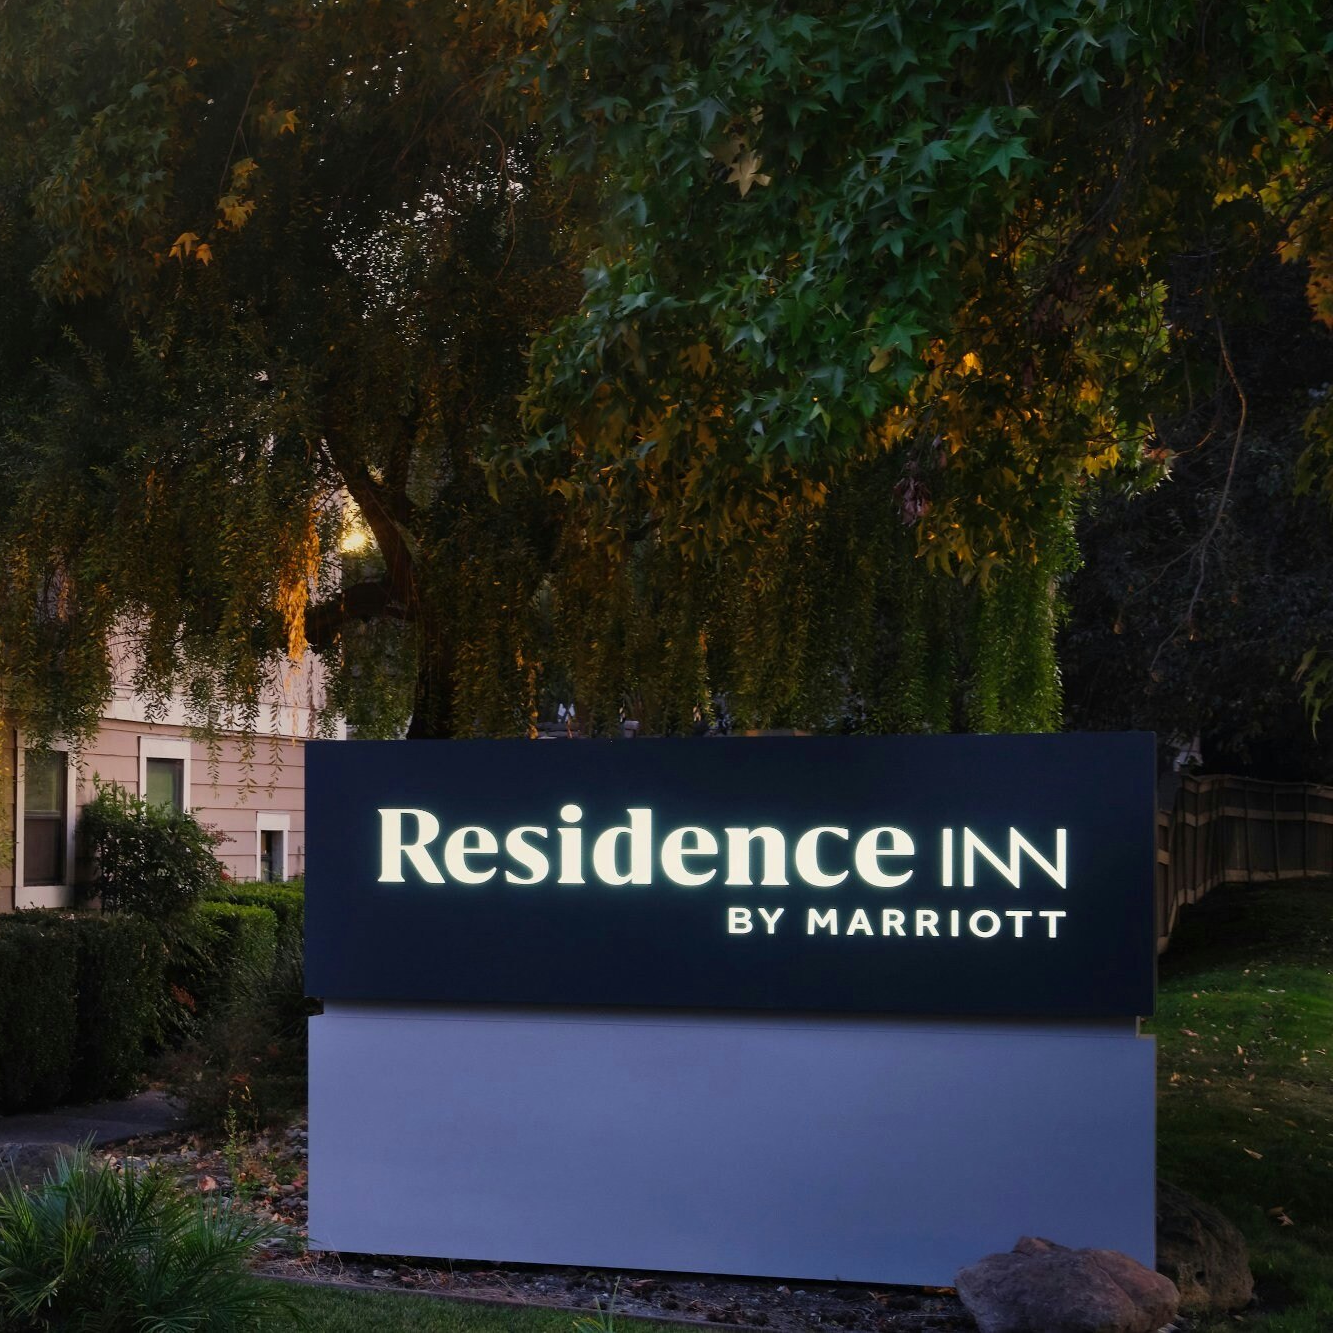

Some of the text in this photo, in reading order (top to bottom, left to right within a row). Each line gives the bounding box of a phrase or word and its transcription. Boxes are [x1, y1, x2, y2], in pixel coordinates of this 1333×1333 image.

[377, 803, 1067, 889] Residence INN
[727, 906, 1067, 939] BY MARRIOTT
